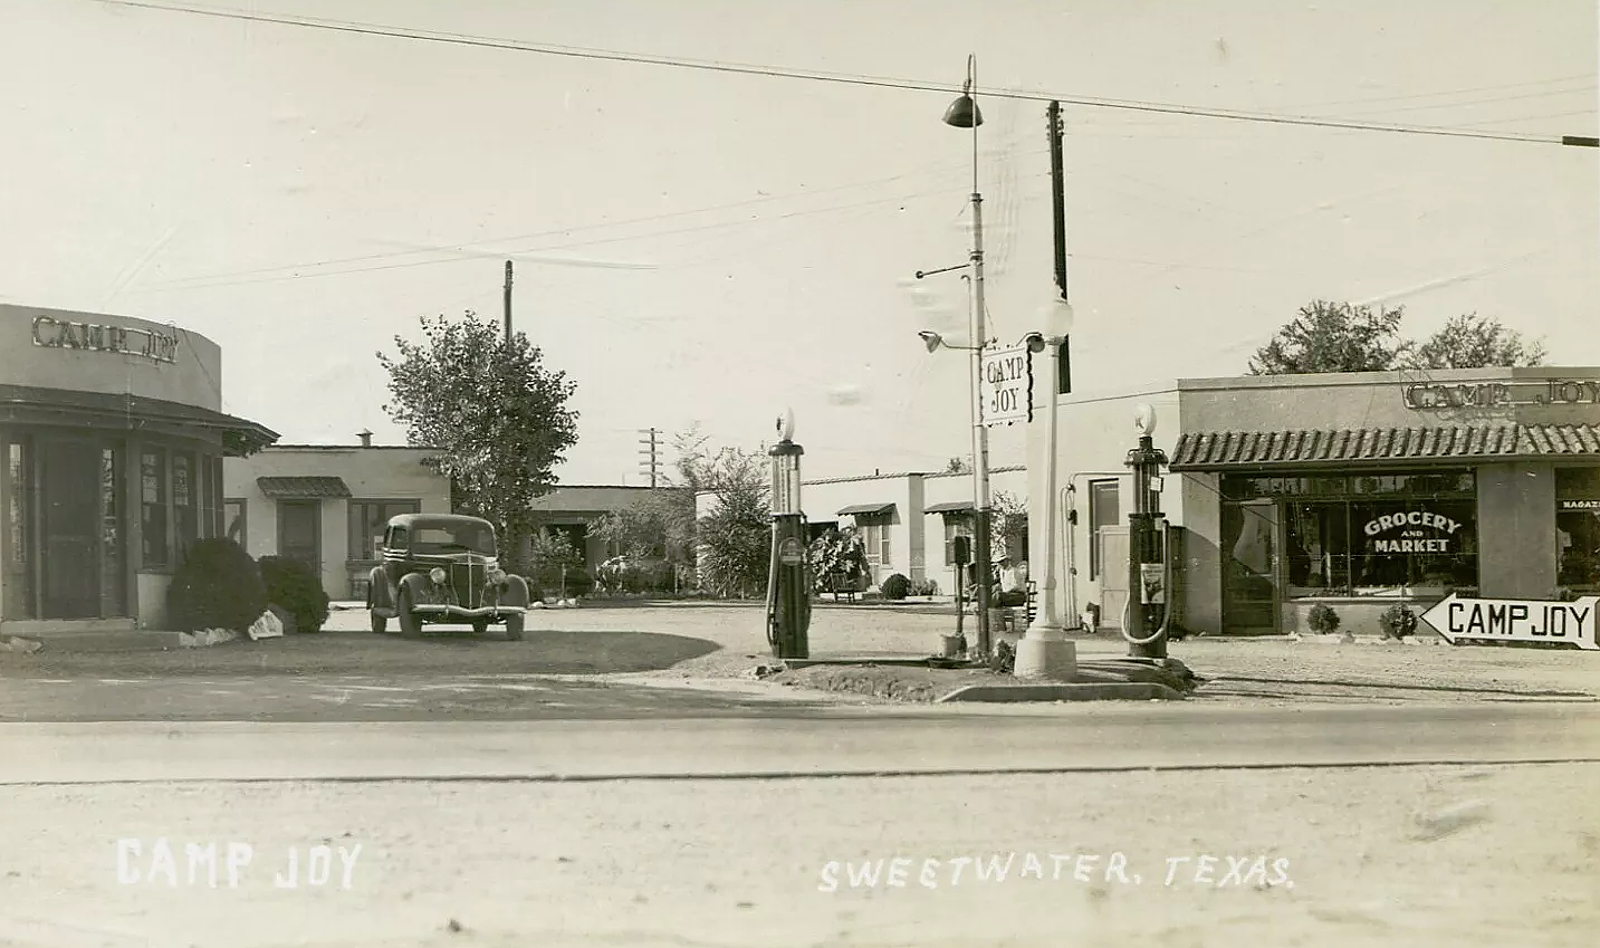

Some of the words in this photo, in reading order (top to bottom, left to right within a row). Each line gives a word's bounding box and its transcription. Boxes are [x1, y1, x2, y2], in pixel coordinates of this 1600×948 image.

[987, 356, 1024, 383] CAMP
[991, 387, 1019, 413] JOY
[1406, 382, 1509, 409] CAMP
[1364, 511, 1462, 536] GROCERY
[1375, 539, 1449, 552] MARKET
[1449, 603, 1528, 635] CAMP
[1531, 606, 1590, 638] JOY
